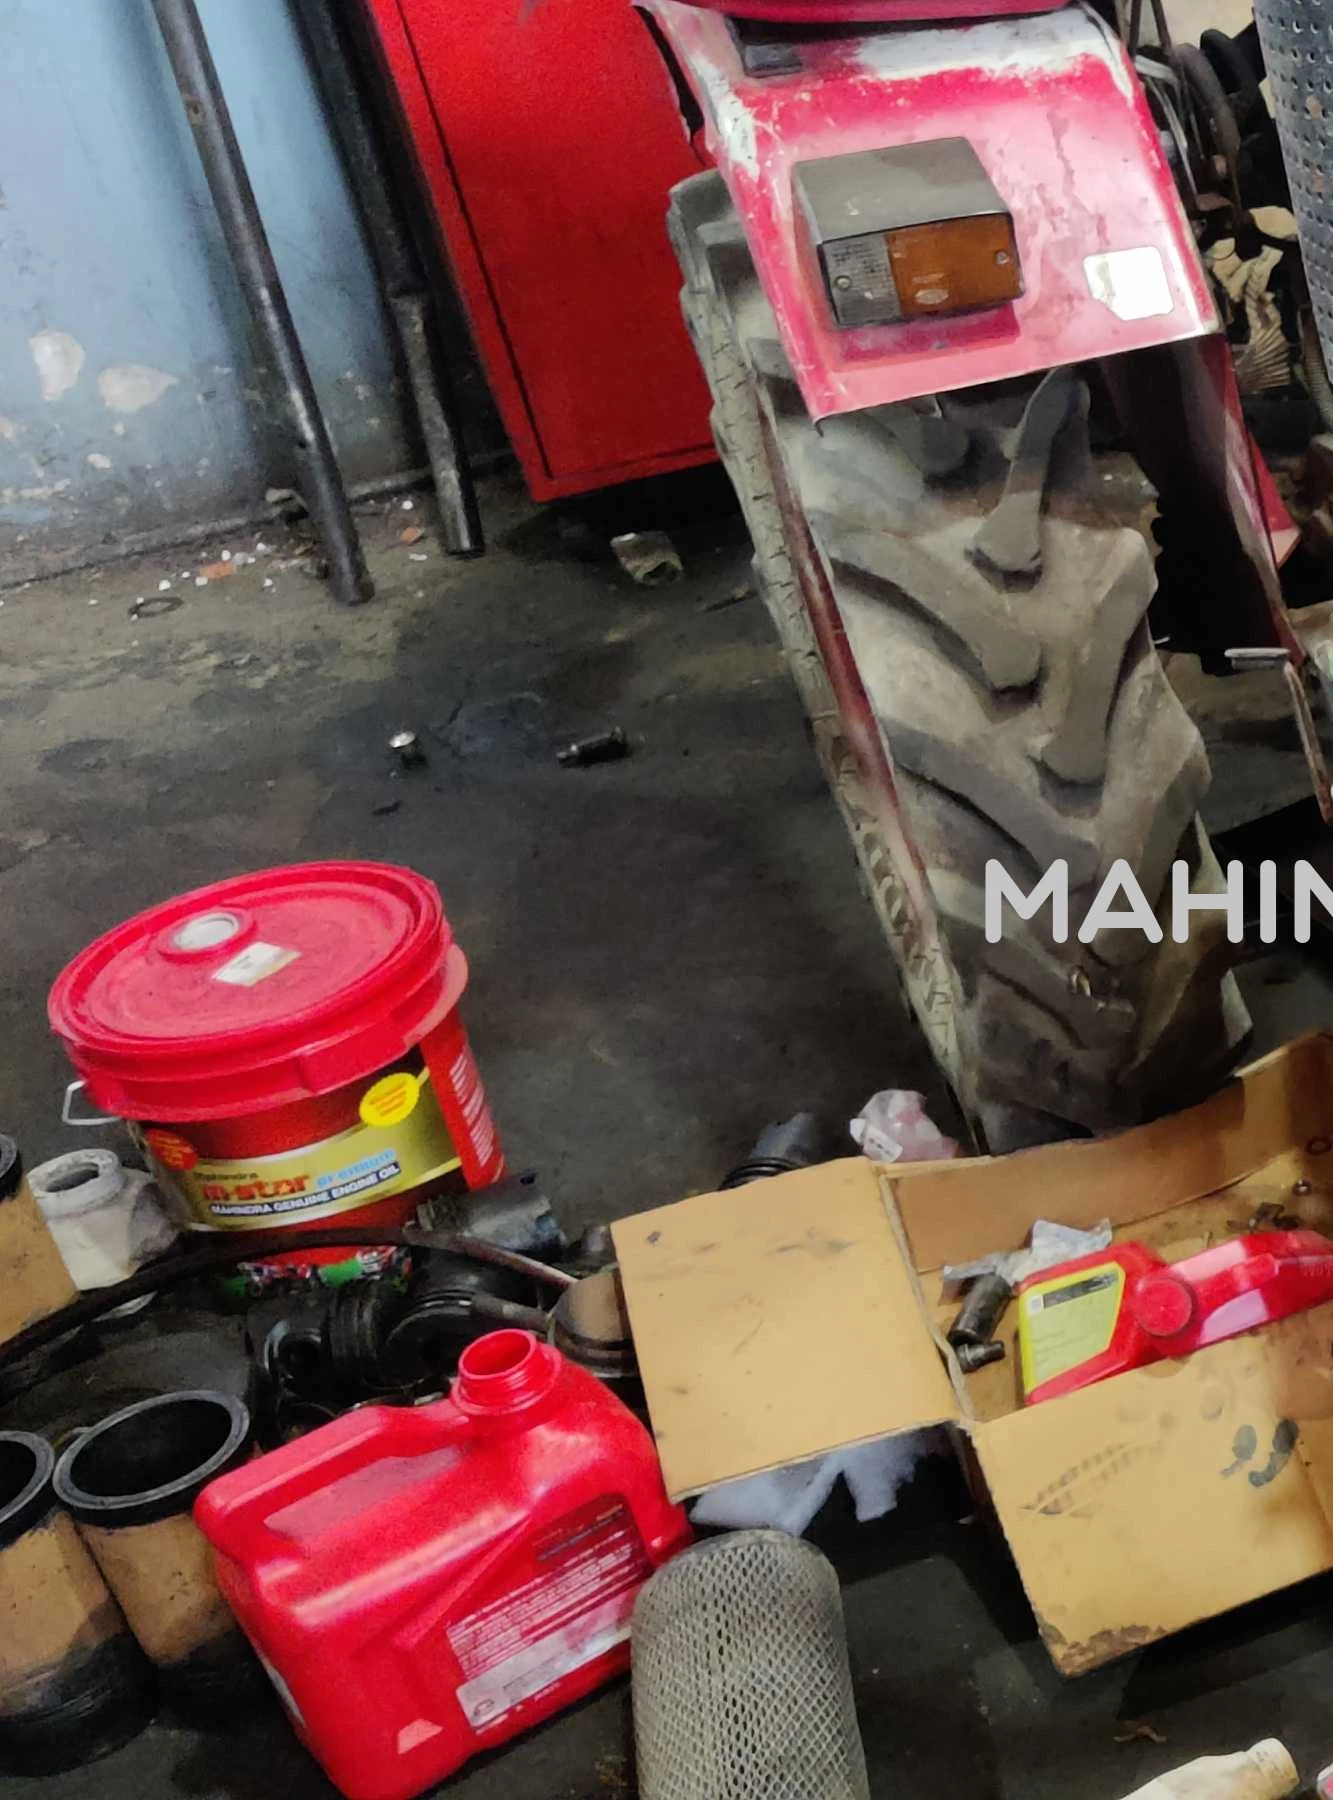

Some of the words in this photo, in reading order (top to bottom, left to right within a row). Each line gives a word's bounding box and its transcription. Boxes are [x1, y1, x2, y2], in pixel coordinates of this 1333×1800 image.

[211, 1203, 273, 1215] MAHINDRA
[274, 1190, 331, 1211] GENUINE
[331, 1174, 379, 1199] ENGINE
[379, 1163, 401, 1179] OIL
